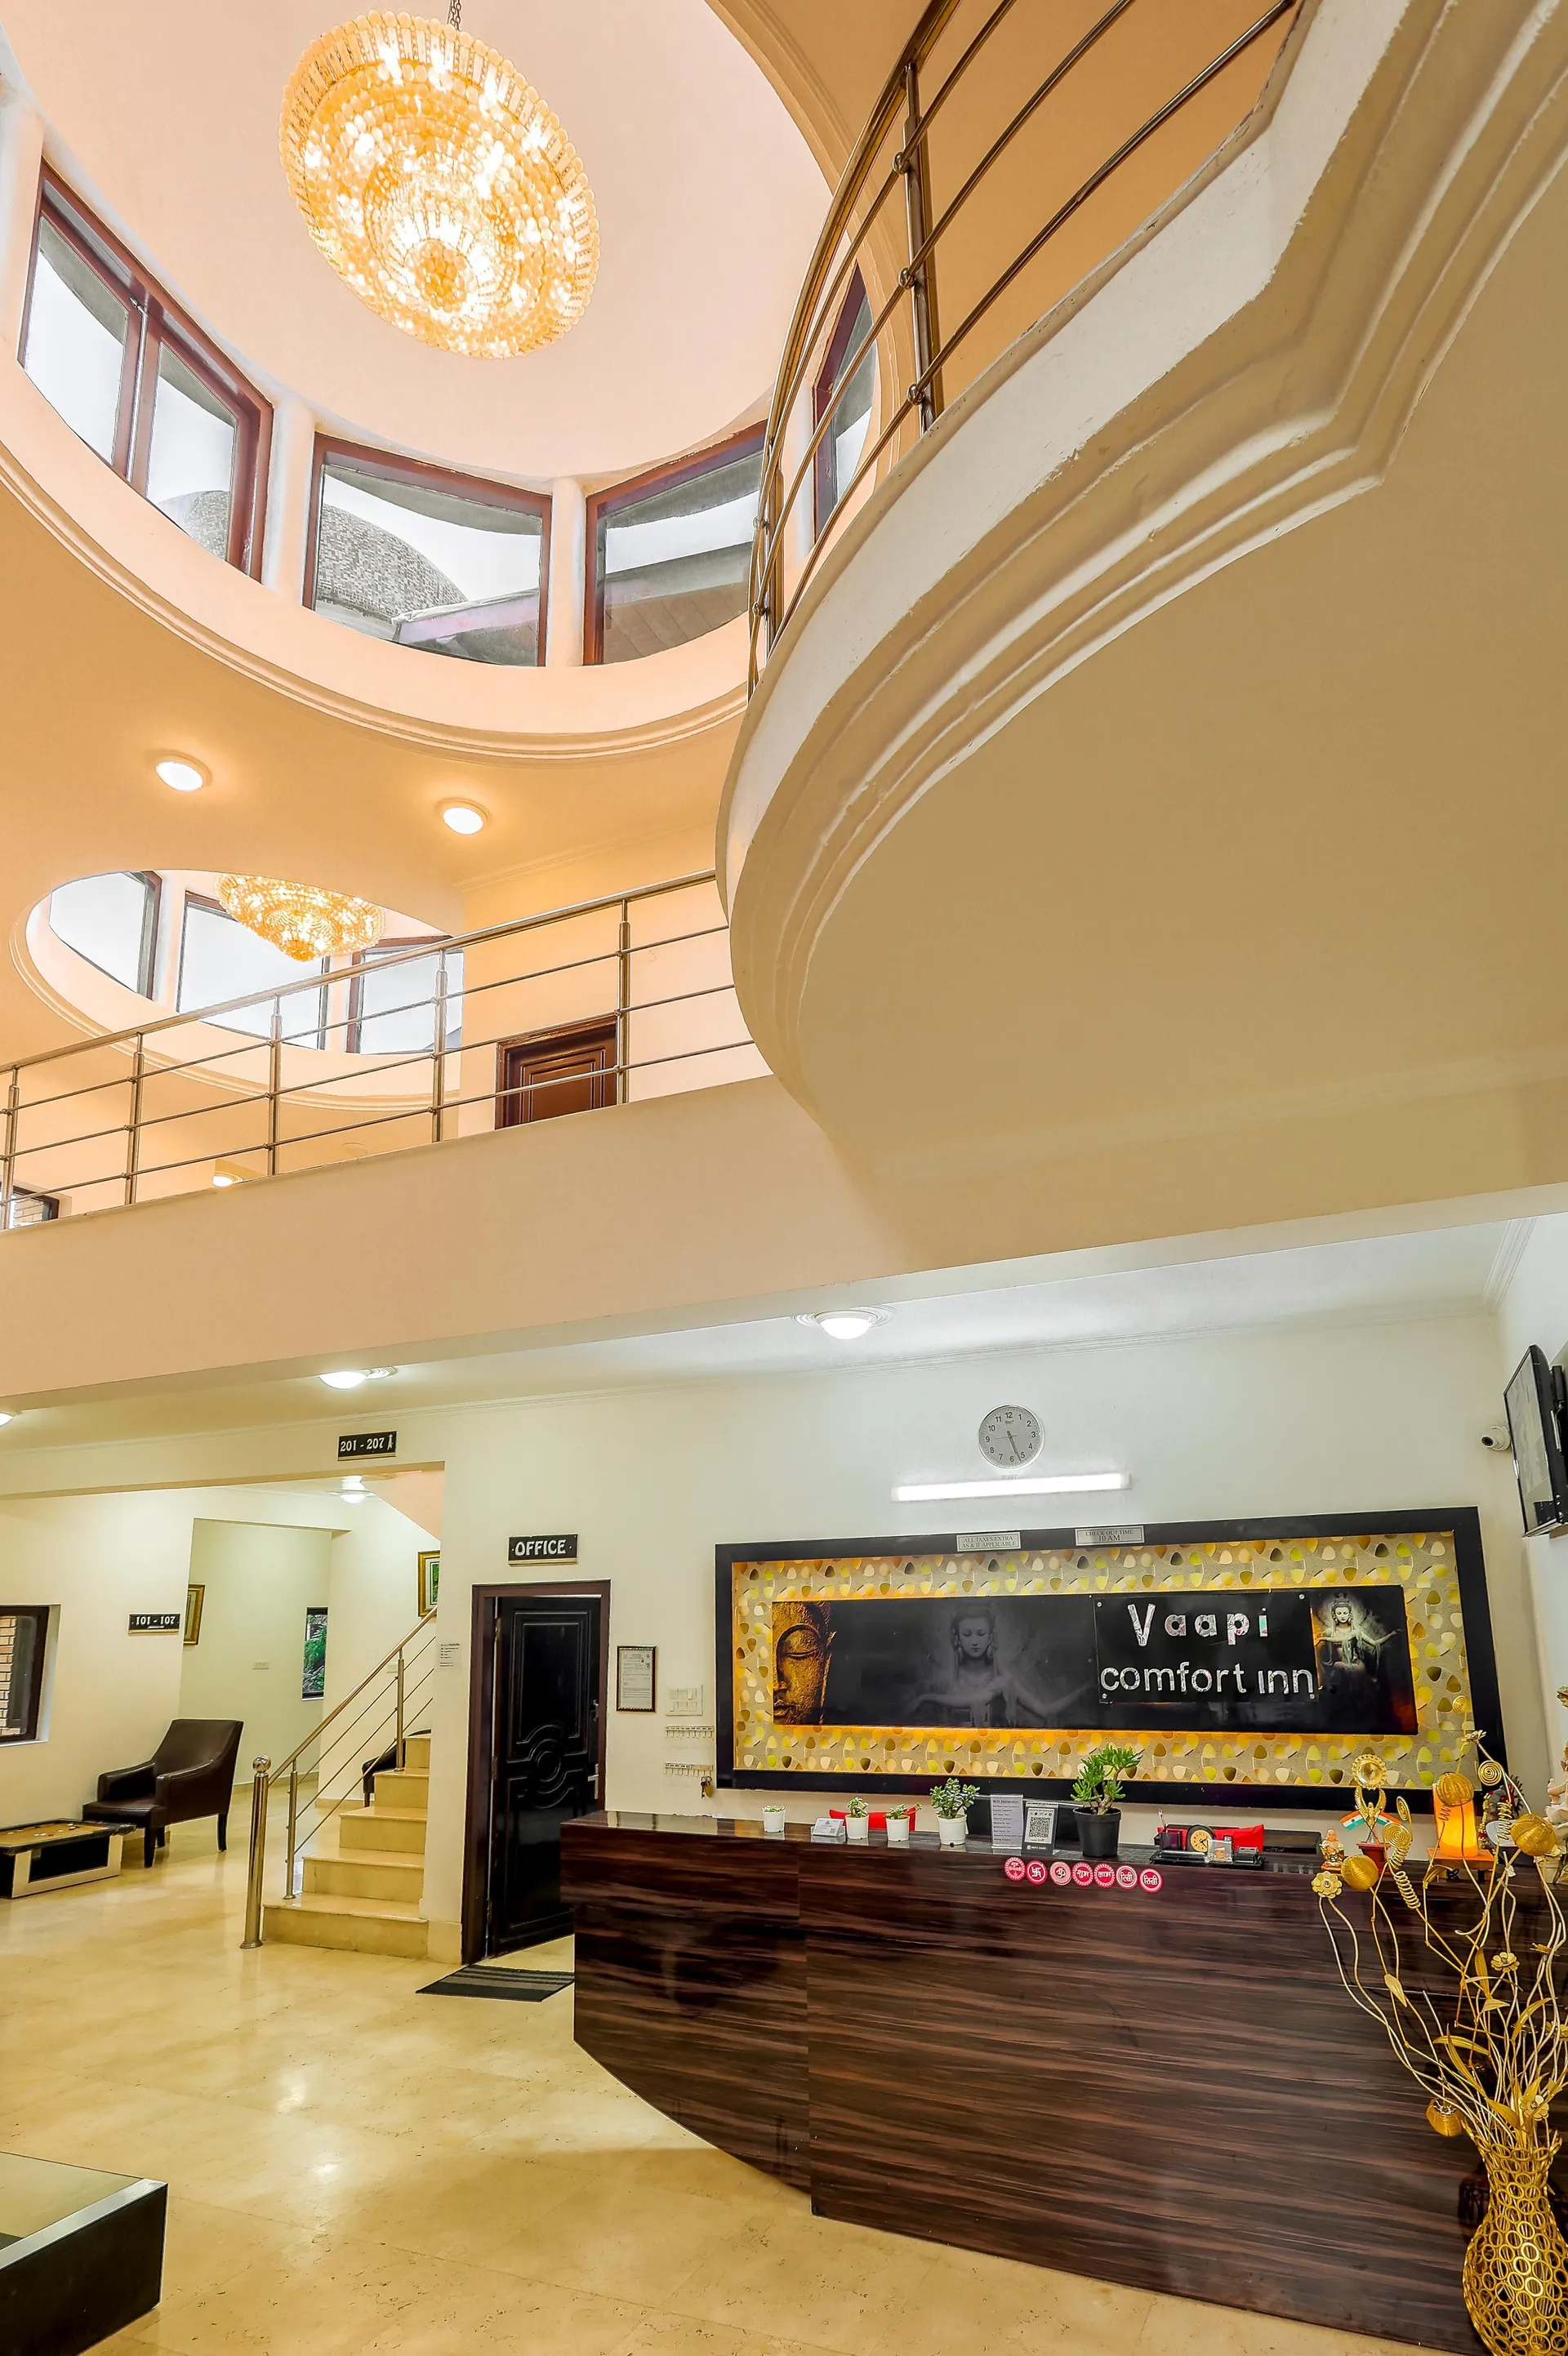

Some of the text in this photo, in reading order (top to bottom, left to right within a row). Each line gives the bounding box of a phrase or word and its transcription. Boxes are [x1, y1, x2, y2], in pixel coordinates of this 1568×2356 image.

[340, 1440, 357, 1452] 201
[366, 1437, 385, 1450] 207
[514, 1539, 566, 1556] OFFICE
[136, 1616, 150, 1625] 101
[1127, 1603, 1268, 1647] Vaapi
[1100, 1661, 1313, 1695] comfort inn
